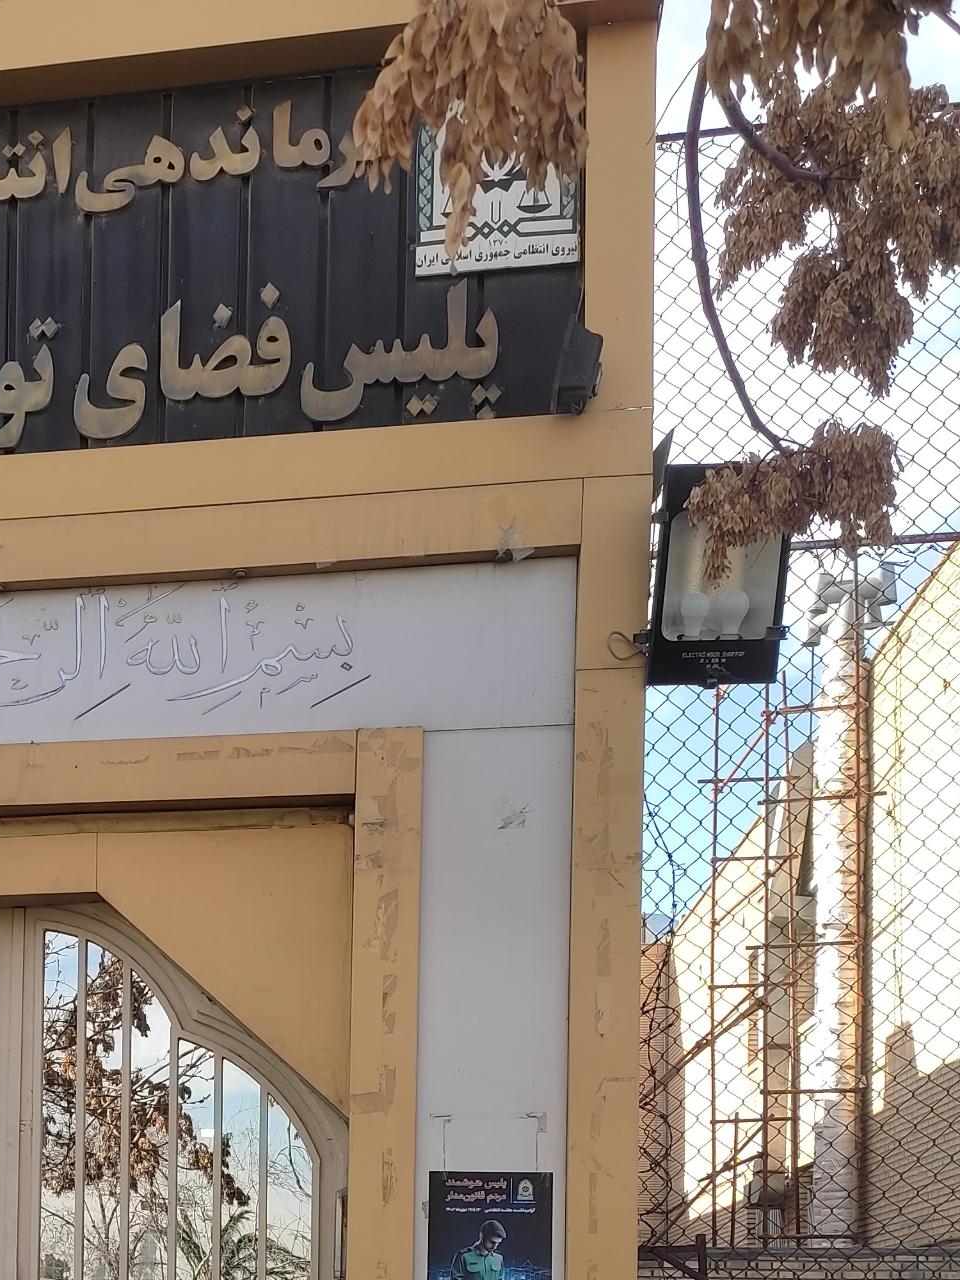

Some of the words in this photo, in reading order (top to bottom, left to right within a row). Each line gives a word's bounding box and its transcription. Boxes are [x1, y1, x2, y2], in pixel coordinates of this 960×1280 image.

[74, 99, 367, 213] رماندهی
[441, 248, 472, 266] اسلای
[474, 248, 511, 263] جمهوری
[513, 243, 549, 260] انتظامی
[551, 240, 578, 257] نیروی
[416, 251, 439, 268] ایران
[301, 279, 501, 420] پلیس
[73, 282, 294, 440] فضای
